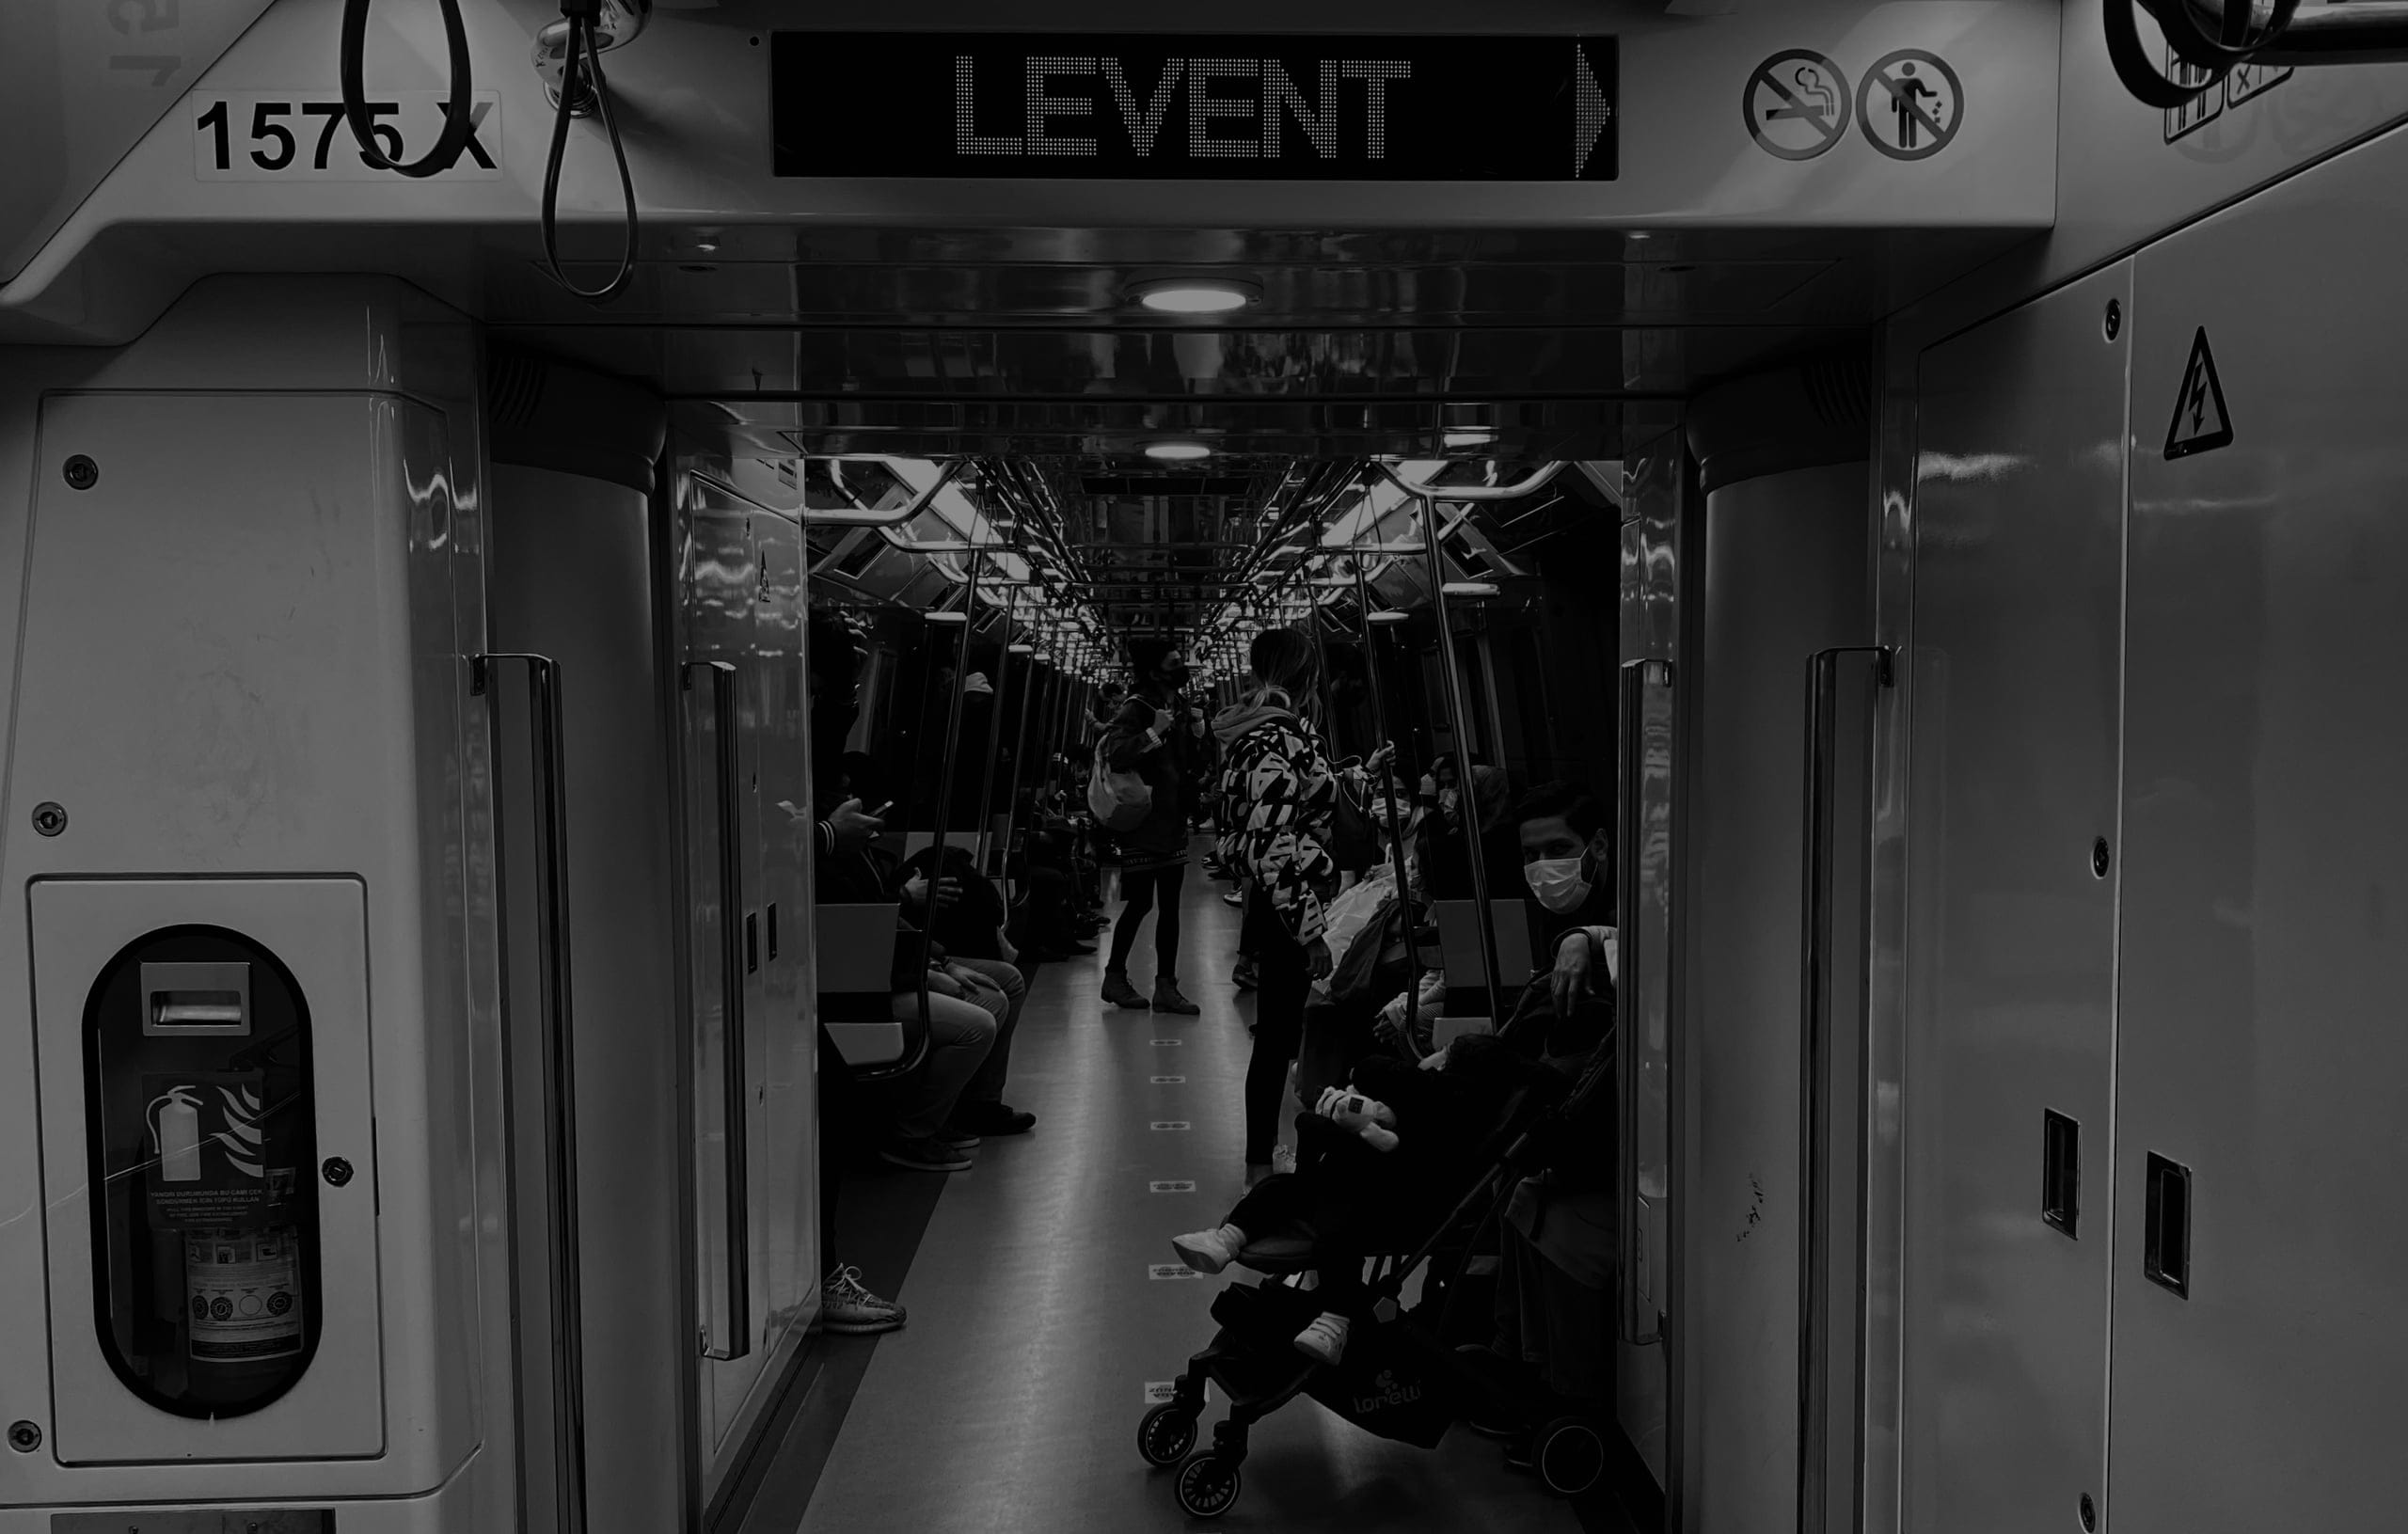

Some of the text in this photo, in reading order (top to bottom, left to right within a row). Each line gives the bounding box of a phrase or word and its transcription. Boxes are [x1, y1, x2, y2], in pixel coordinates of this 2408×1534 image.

[198, 101, 497, 170] 1575 X
[956, 55, 1412, 159] LEVENT
